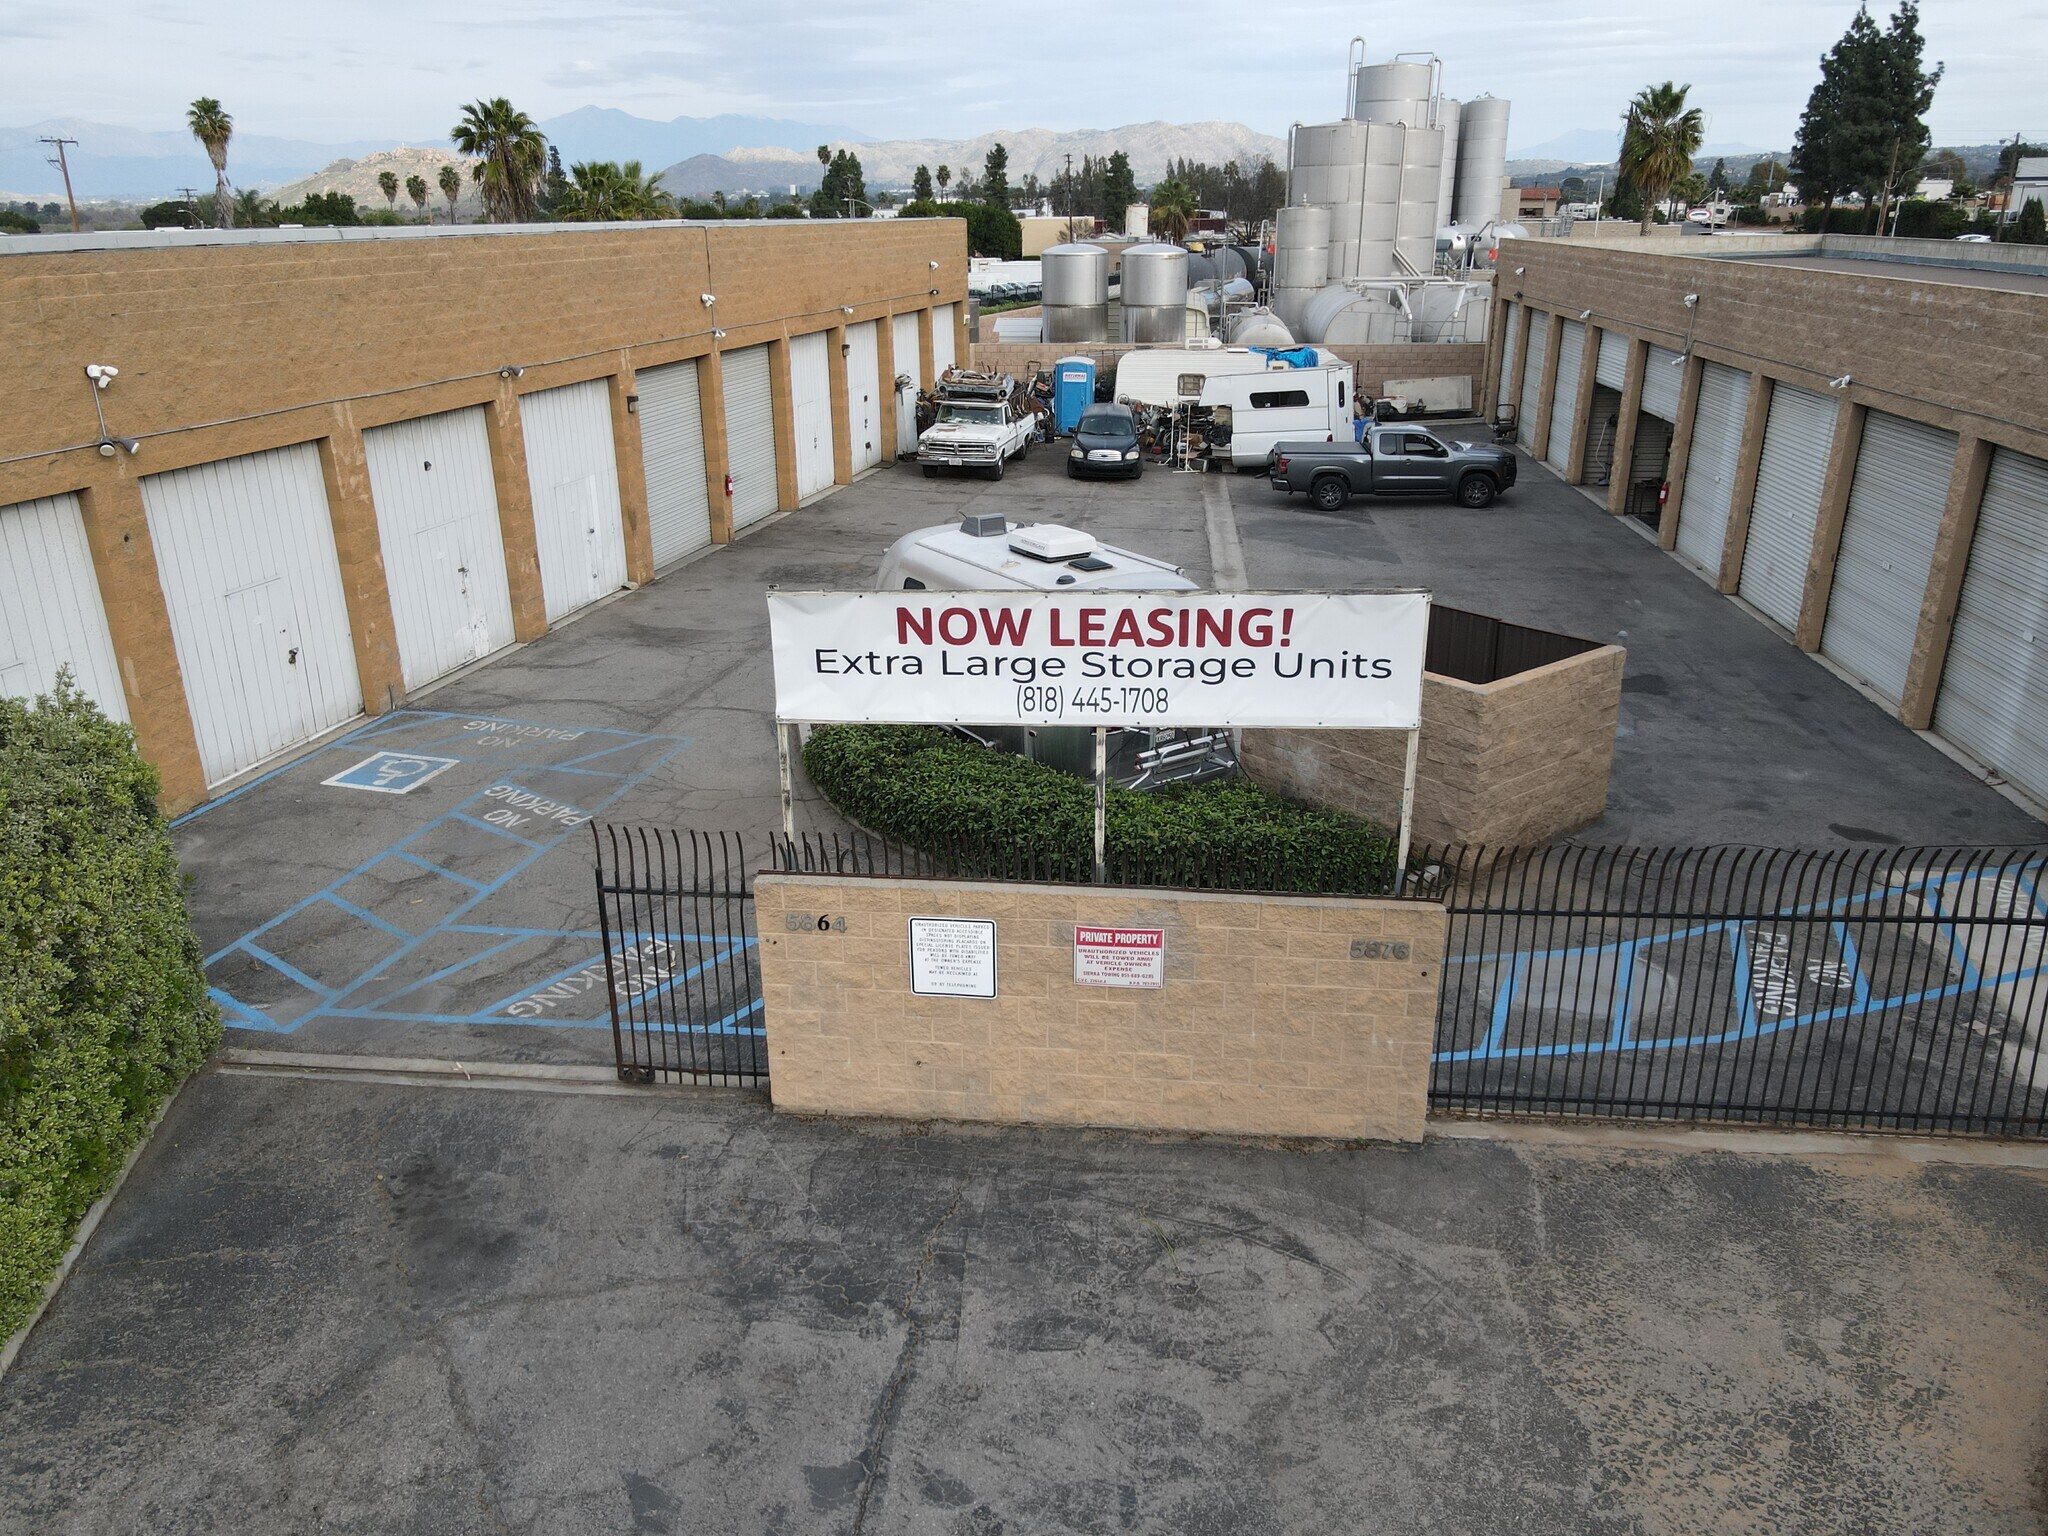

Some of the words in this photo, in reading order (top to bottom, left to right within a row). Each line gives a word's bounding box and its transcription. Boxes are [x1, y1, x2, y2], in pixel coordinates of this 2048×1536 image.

[896, 606, 1032, 646] NOW
[1050, 608, 1294, 648] LEASING!
[815, 648, 923, 676] Extra
[942, 650, 1066, 684] Large
[1081, 651, 1256, 685] Storage
[1273, 650, 1392, 679] Units
[1016, 684, 1064, 718] (818)
[1072, 687, 1169, 714] 445-1708
[464, 720, 585, 740] PARKING
[478, 736, 522, 748] NO
[484, 786, 593, 826] PARKING
[484, 810, 531, 828] NO
[1080, 931, 1113, 943] PRIVATE
[1115, 933, 1158, 944] PROPERTY
[1350, 940, 1410, 960] 5876
[507, 936, 674, 1018] PARKING
[615, 966, 676, 996] NO
[1748, 930, 1797, 1016] PARKING
[1807, 958, 1852, 988] NO
